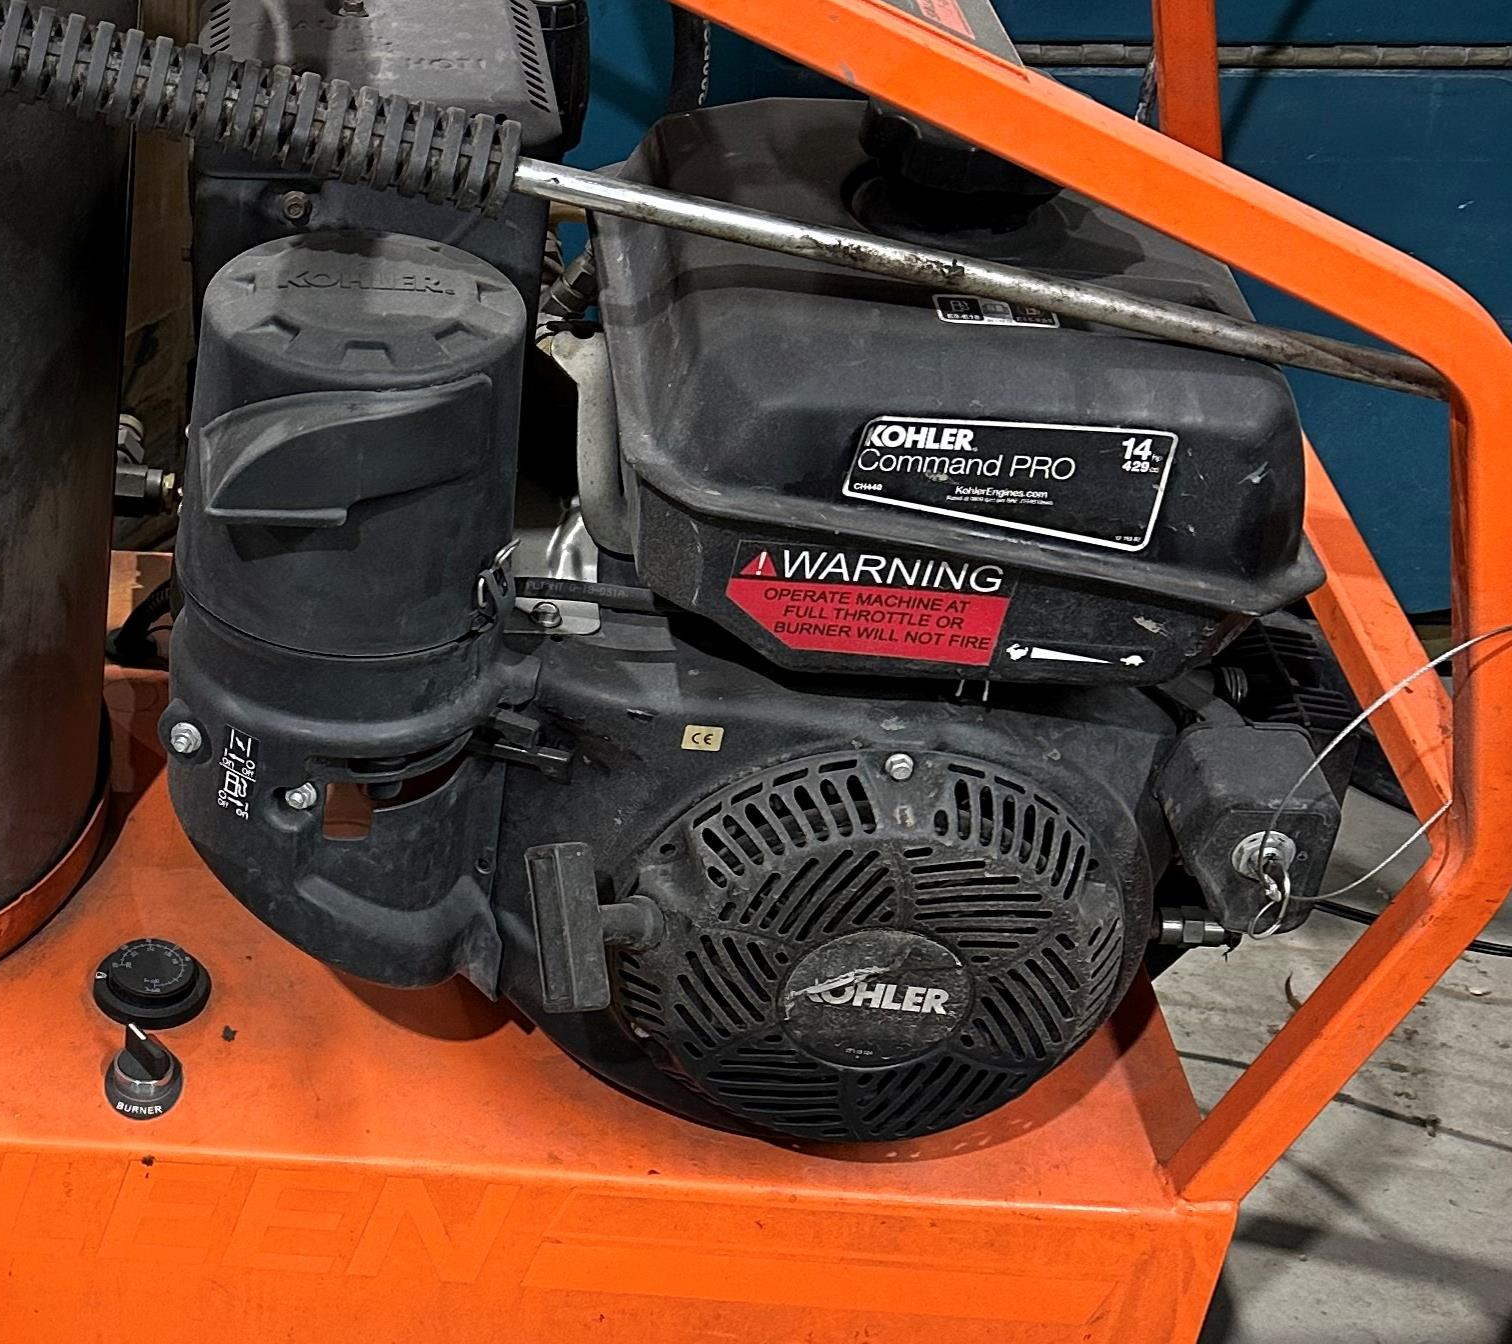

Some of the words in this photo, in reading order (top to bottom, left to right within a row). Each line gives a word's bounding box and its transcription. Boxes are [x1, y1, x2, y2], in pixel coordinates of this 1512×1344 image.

[865, 424, 974, 452] KOHLER
[1121, 437, 1153, 460] 14
[857, 448, 1003, 477] Command
[1009, 455, 1076, 480] PRO
[1121, 461, 1150, 473] 429
[955, 485, 1048, 499] KohlerEngines.com
[784, 549, 1004, 593] WARNING
[764, 587, 851, 605] OPERATE
[856, 594, 943, 611] MACHINE
[944, 599, 971, 614] AT
[783, 605, 827, 620] FULL
[833, 609, 929, 627] THROTTLE
[935, 616, 965, 630] OR
[774, 622, 851, 638] BURNER
[856, 627, 899, 642] WILL
[903, 632, 945, 646] NOT
[947, 635, 993, 651] FIRE
[116, 1101, 164, 1116] BURNER
